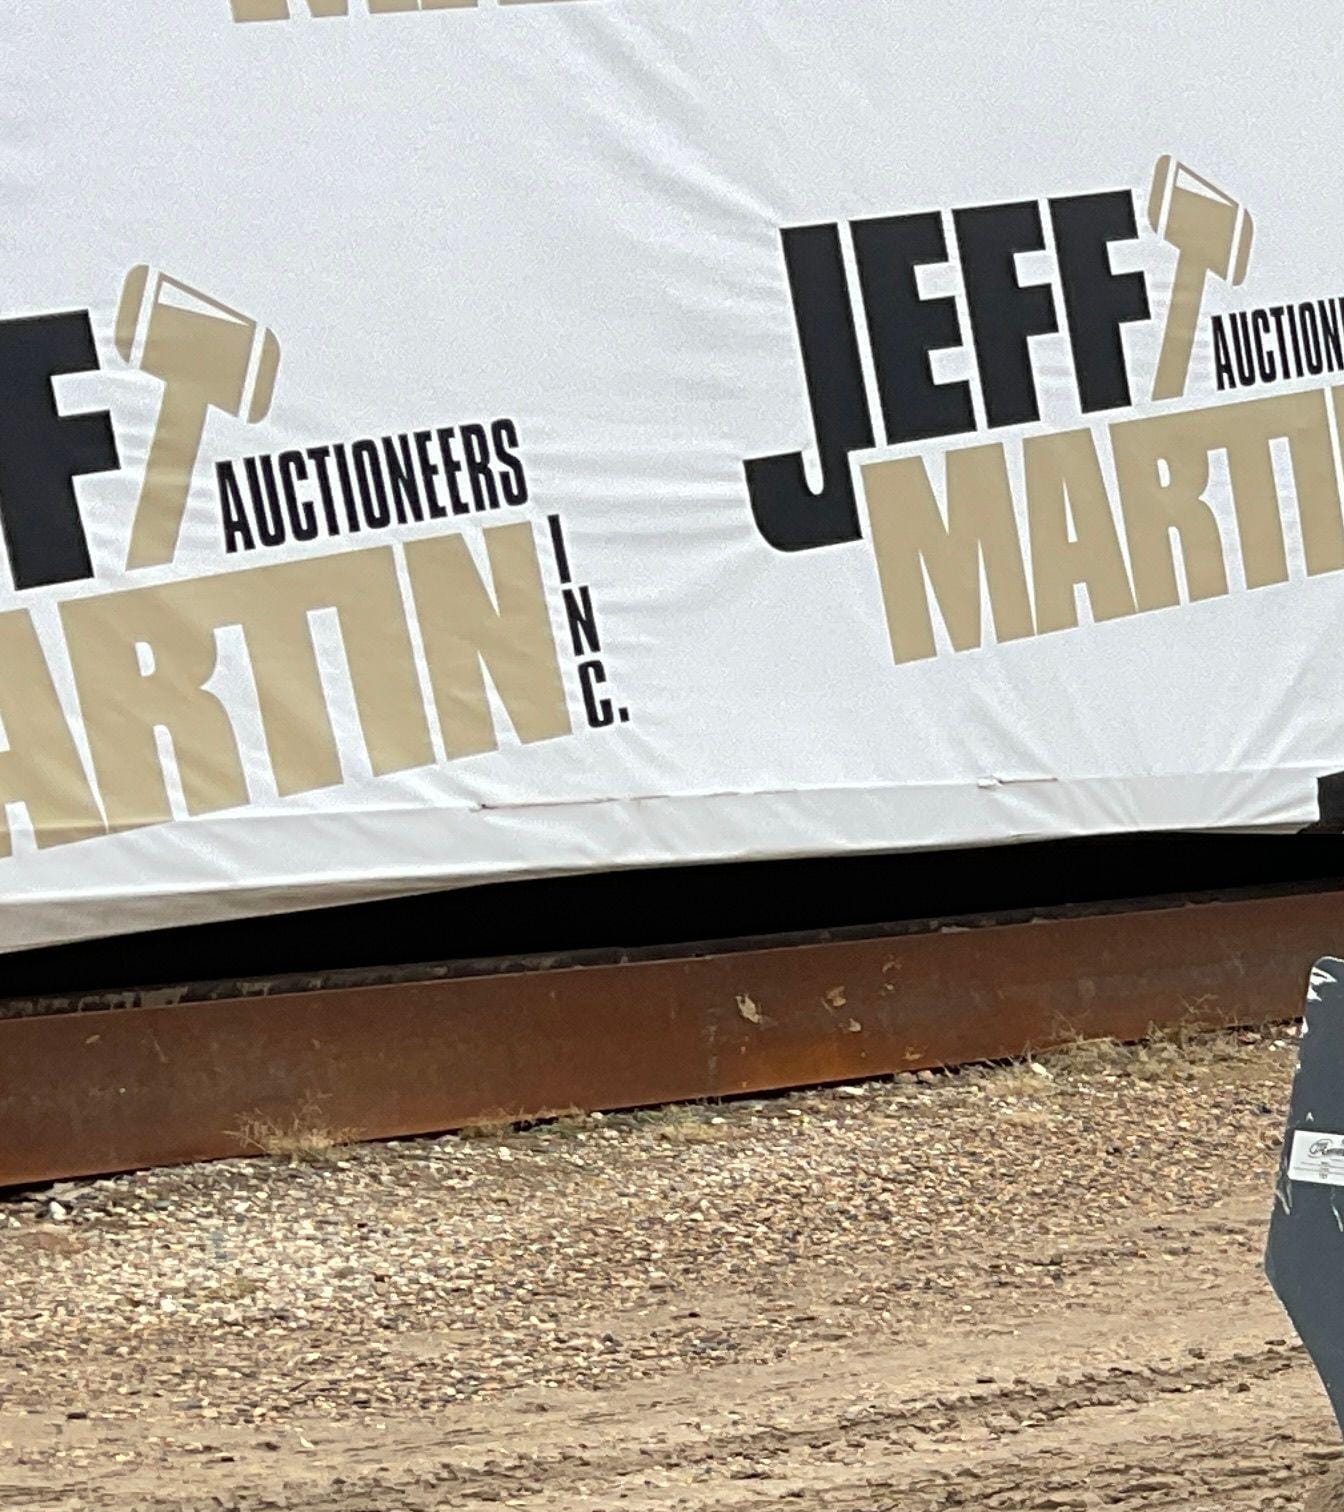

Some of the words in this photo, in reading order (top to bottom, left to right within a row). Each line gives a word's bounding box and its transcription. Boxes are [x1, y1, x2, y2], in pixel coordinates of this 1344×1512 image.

[215, 418, 529, 554] AUCTIONEERS
[743, 188, 1151, 552] JEFF
[0, 521, 573, 857] ARTIN
